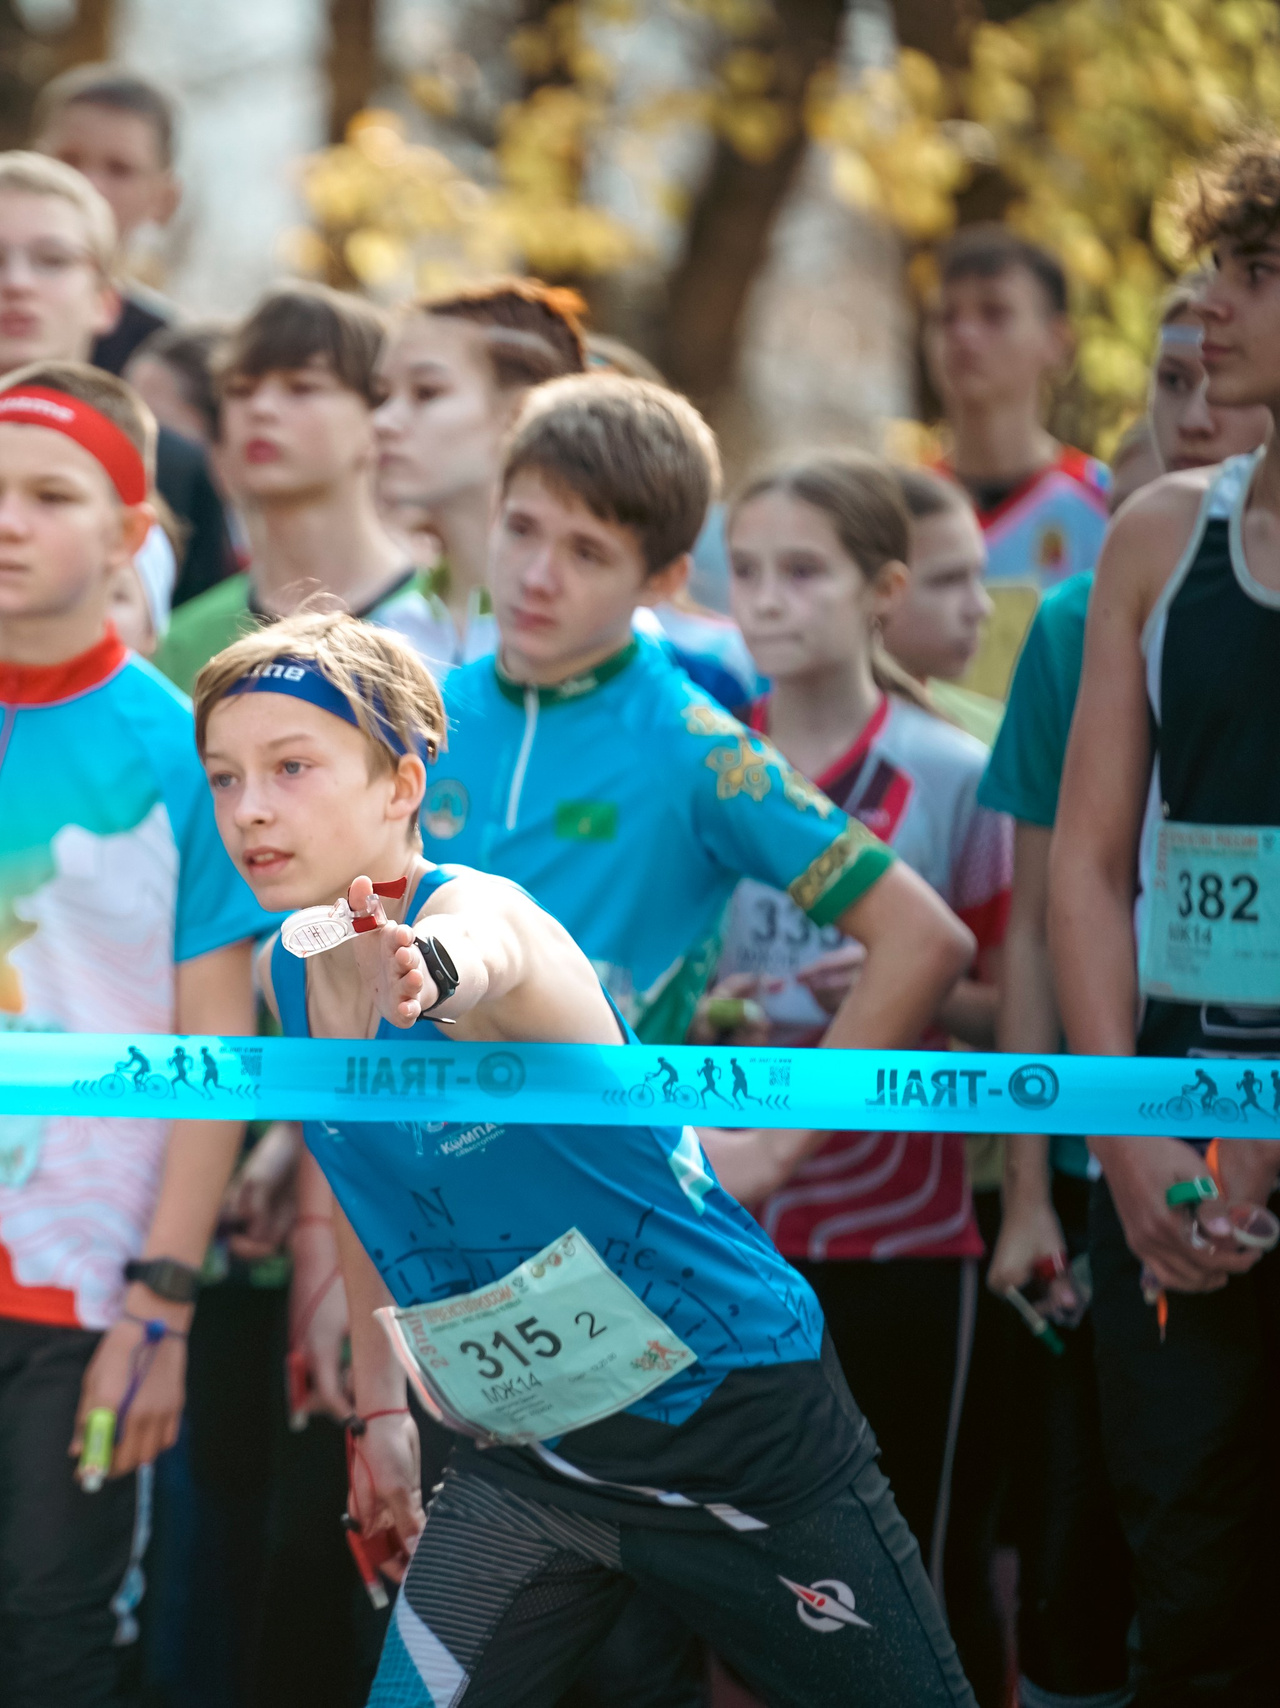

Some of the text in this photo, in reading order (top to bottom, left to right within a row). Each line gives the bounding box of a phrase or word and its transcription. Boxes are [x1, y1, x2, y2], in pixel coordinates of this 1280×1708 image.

[1177, 869, 1260, 923] 382
[409, 1186, 455, 1228] N
[459, 1315, 563, 1380] 315
[574, 1311, 608, 1341] 2
[481, 1373, 543, 1405] МЖ14
